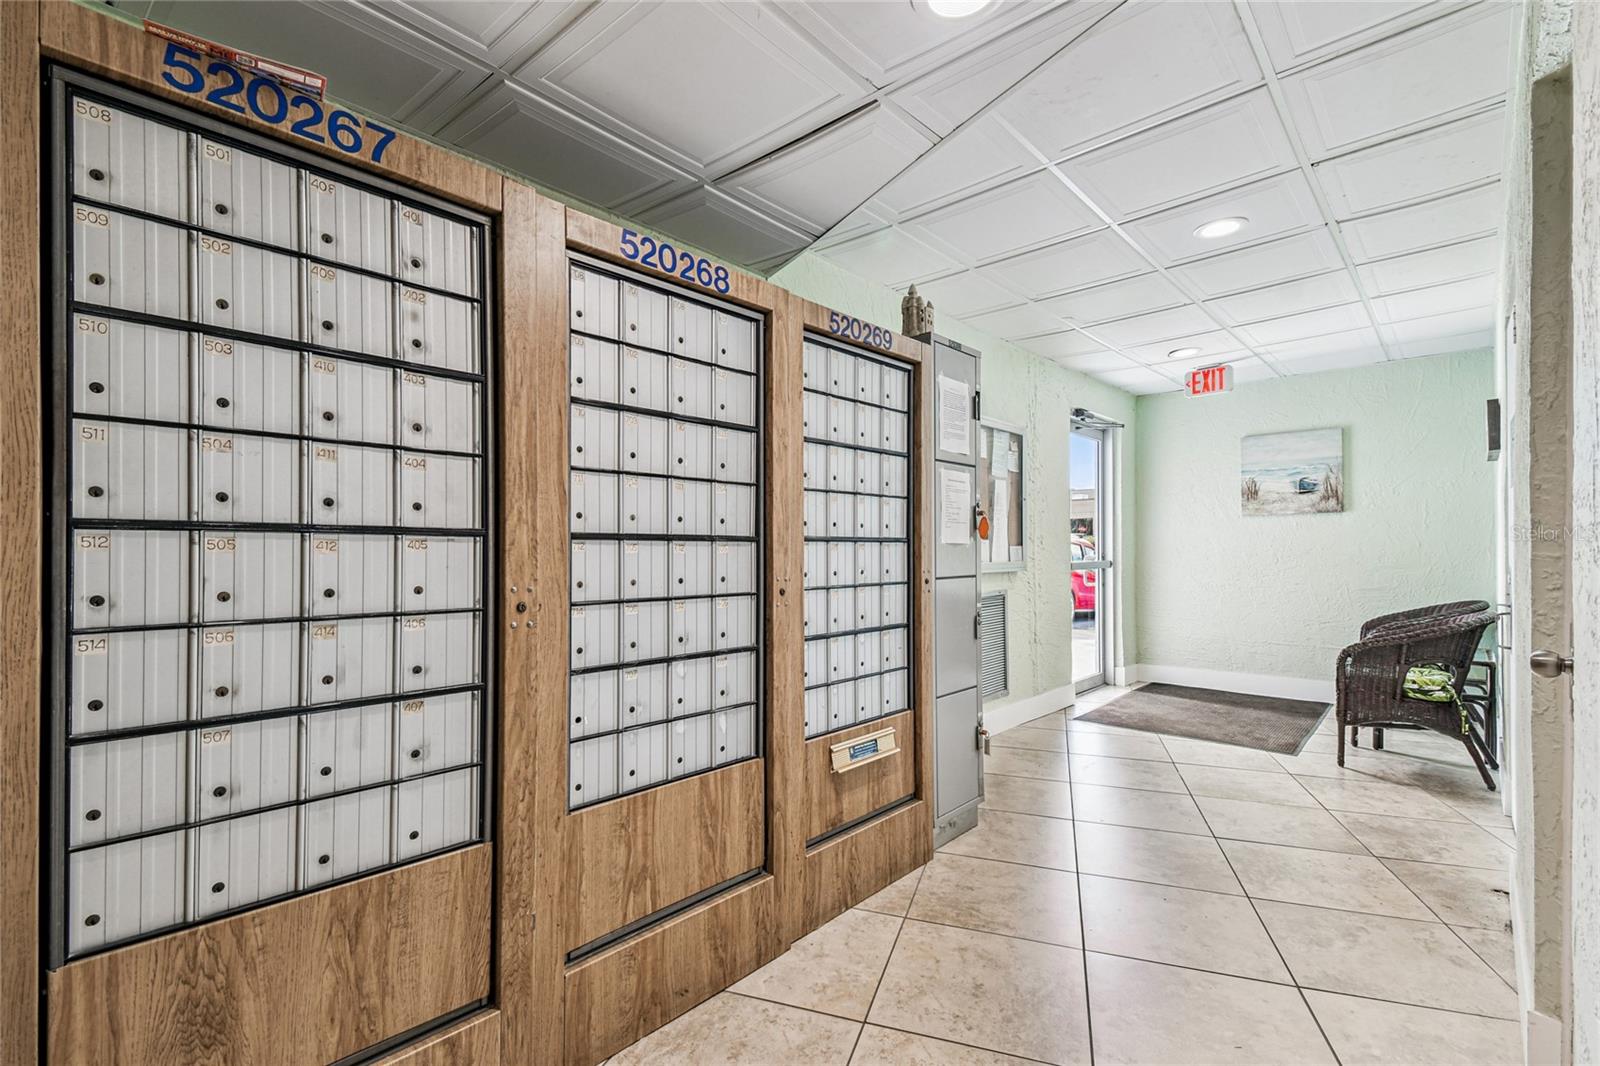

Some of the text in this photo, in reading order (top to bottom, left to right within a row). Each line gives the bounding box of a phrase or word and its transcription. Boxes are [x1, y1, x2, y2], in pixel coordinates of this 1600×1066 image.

[161, 43, 396, 163] 520267
[76, 101, 112, 124] 508
[206, 144, 230, 162] 501
[76, 208, 109, 227] 509
[201, 237, 231, 254] 502
[620, 228, 730, 294] 520268
[311, 265, 336, 281] 409
[79, 318, 108, 335] 510
[829, 311, 893, 350] 520269
[204, 340, 233, 355] 503
[314, 360, 335, 373] 410
[403, 373, 426, 385] 403
[1192, 367, 1226, 395] EXIT
[82, 427, 105, 441] 511
[203, 438, 233, 450] 504
[405, 458, 426, 468] 404
[80, 535, 109, 549] 512
[206, 539, 236, 551] 505
[315, 541, 337, 552] 412
[407, 540, 428, 550] 405
[204, 631, 234, 645] 506
[314, 625, 335, 637] 414
[78, 639, 106, 653] 514
[404, 701, 425, 713] 407
[203, 730, 231, 744] 507
